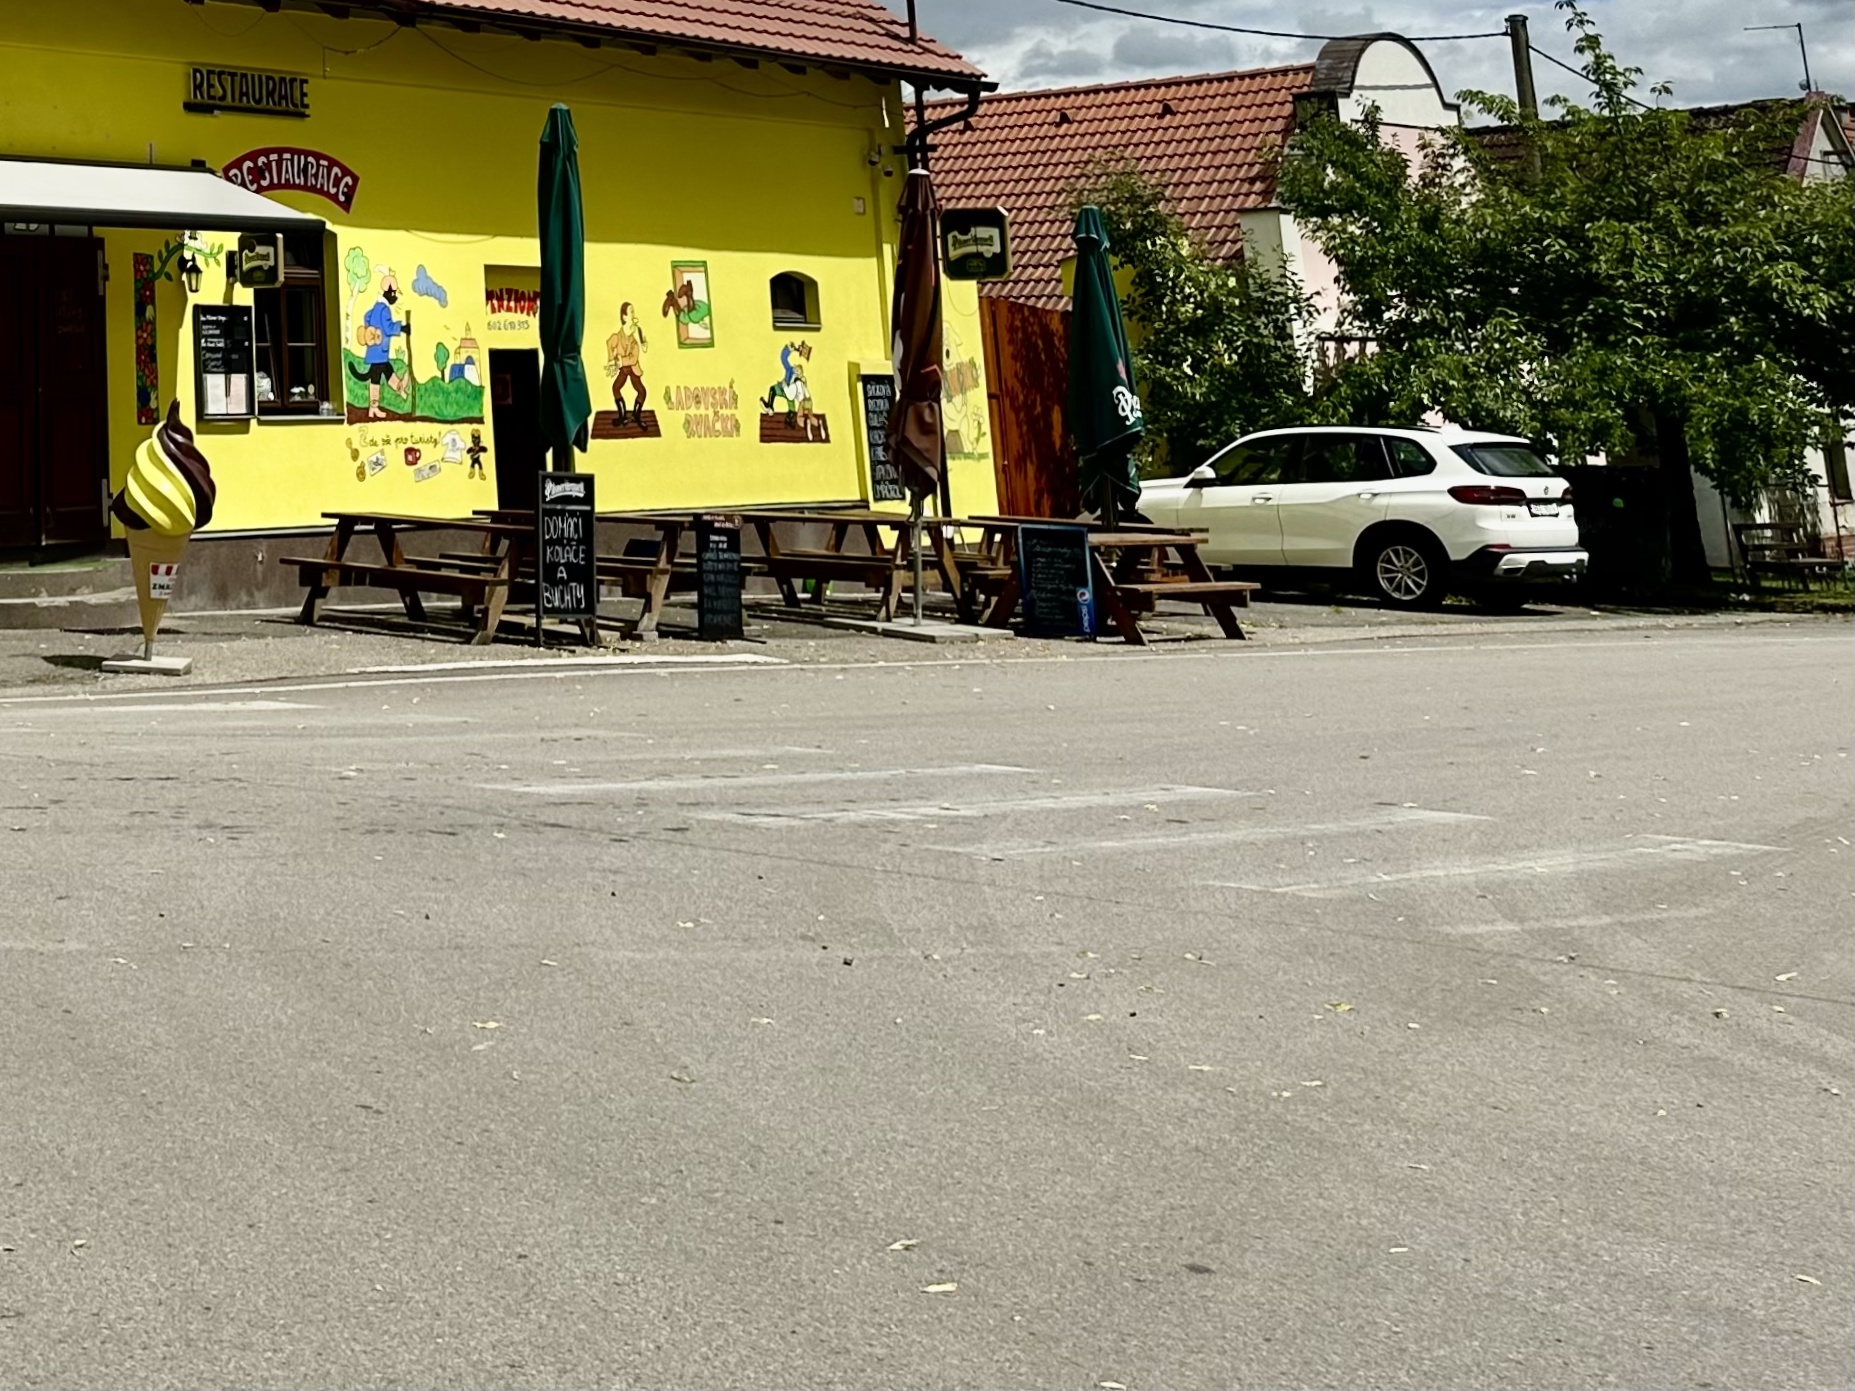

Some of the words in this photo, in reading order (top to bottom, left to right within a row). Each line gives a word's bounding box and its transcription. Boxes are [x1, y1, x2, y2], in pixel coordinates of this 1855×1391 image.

[191, 68, 310, 109] RESTAURACE
[556, 566, 567, 581] A
[543, 582, 585, 609] BUCHTY
